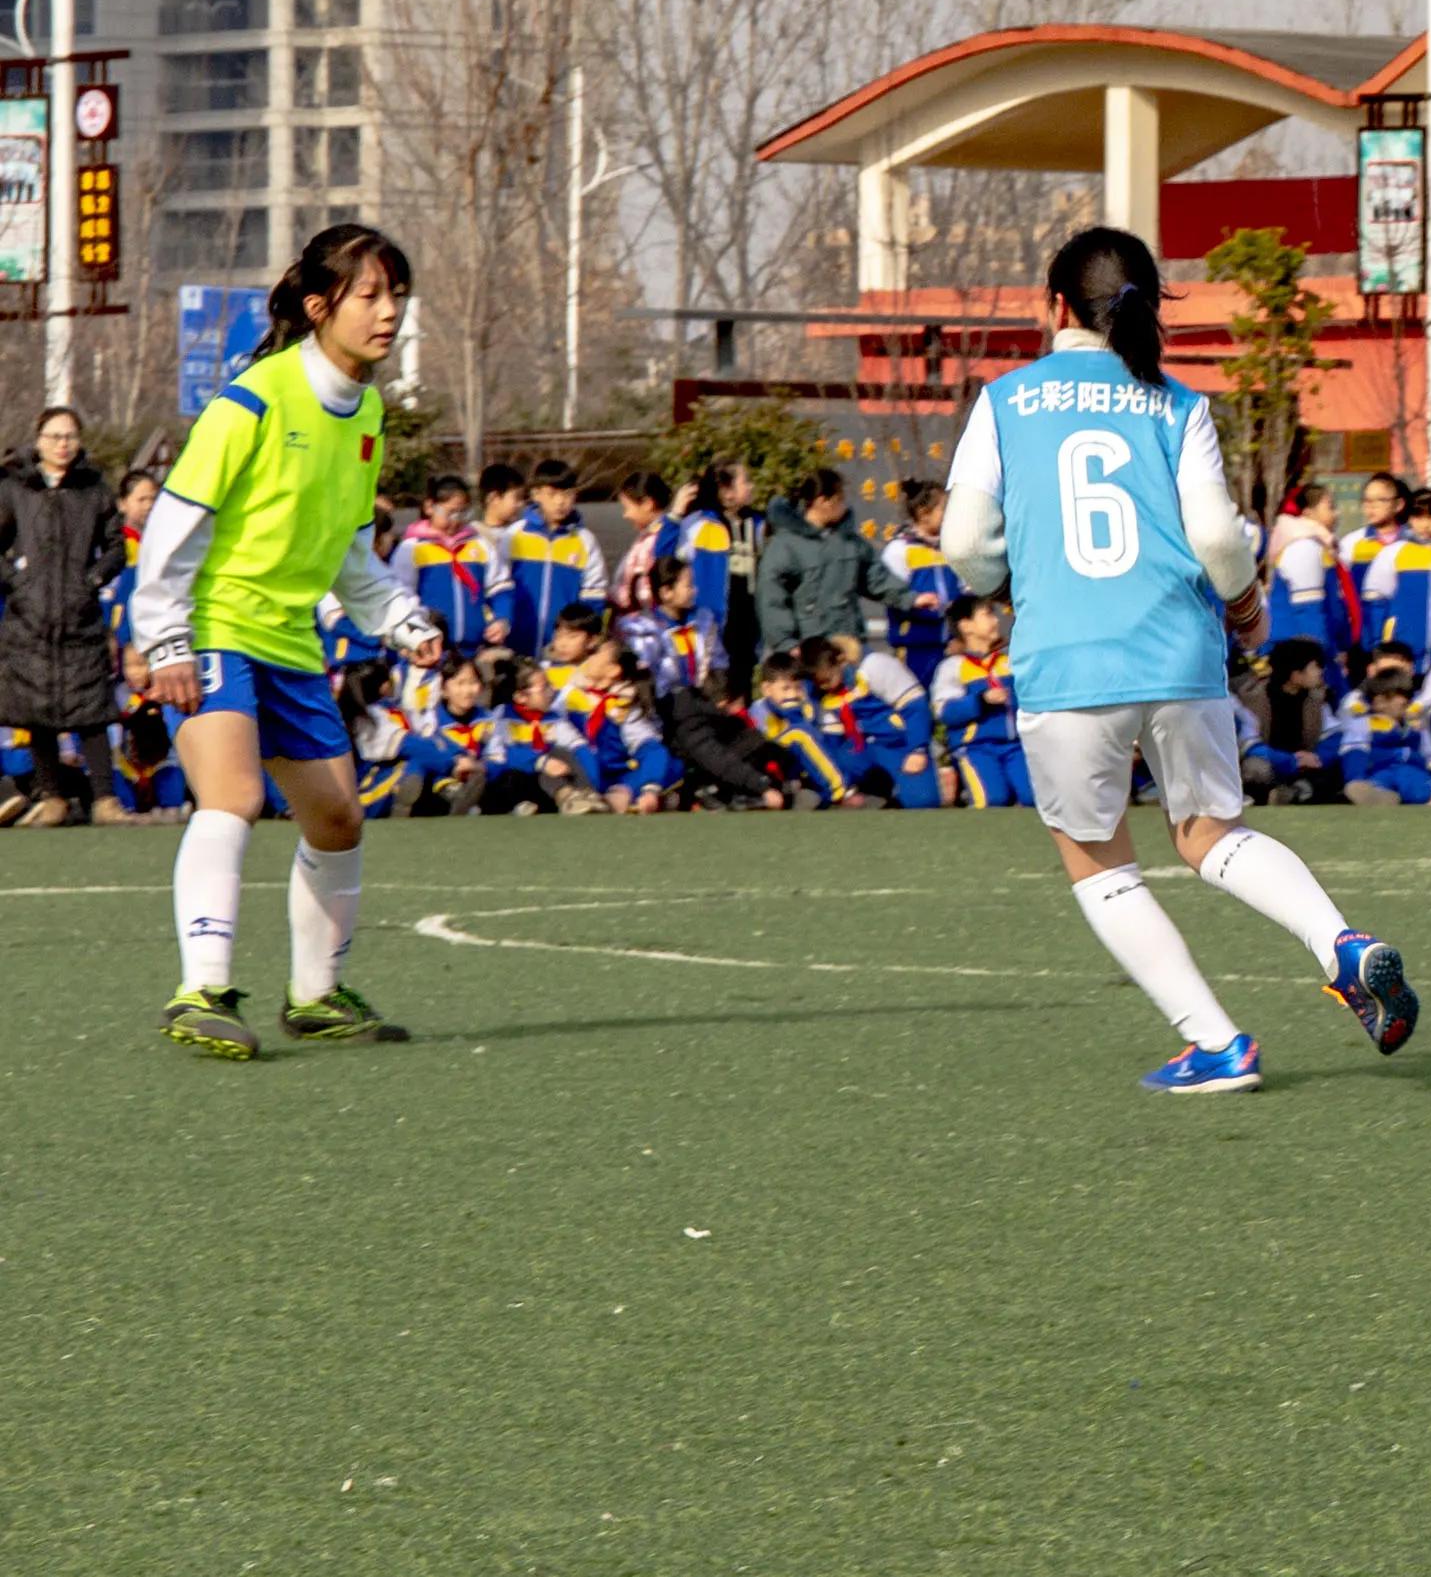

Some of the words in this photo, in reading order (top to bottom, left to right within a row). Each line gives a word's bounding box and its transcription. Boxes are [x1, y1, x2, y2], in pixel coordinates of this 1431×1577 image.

[1008, 379, 1177, 426] 七彩阳光队
[1057, 429, 1140, 579] 6
